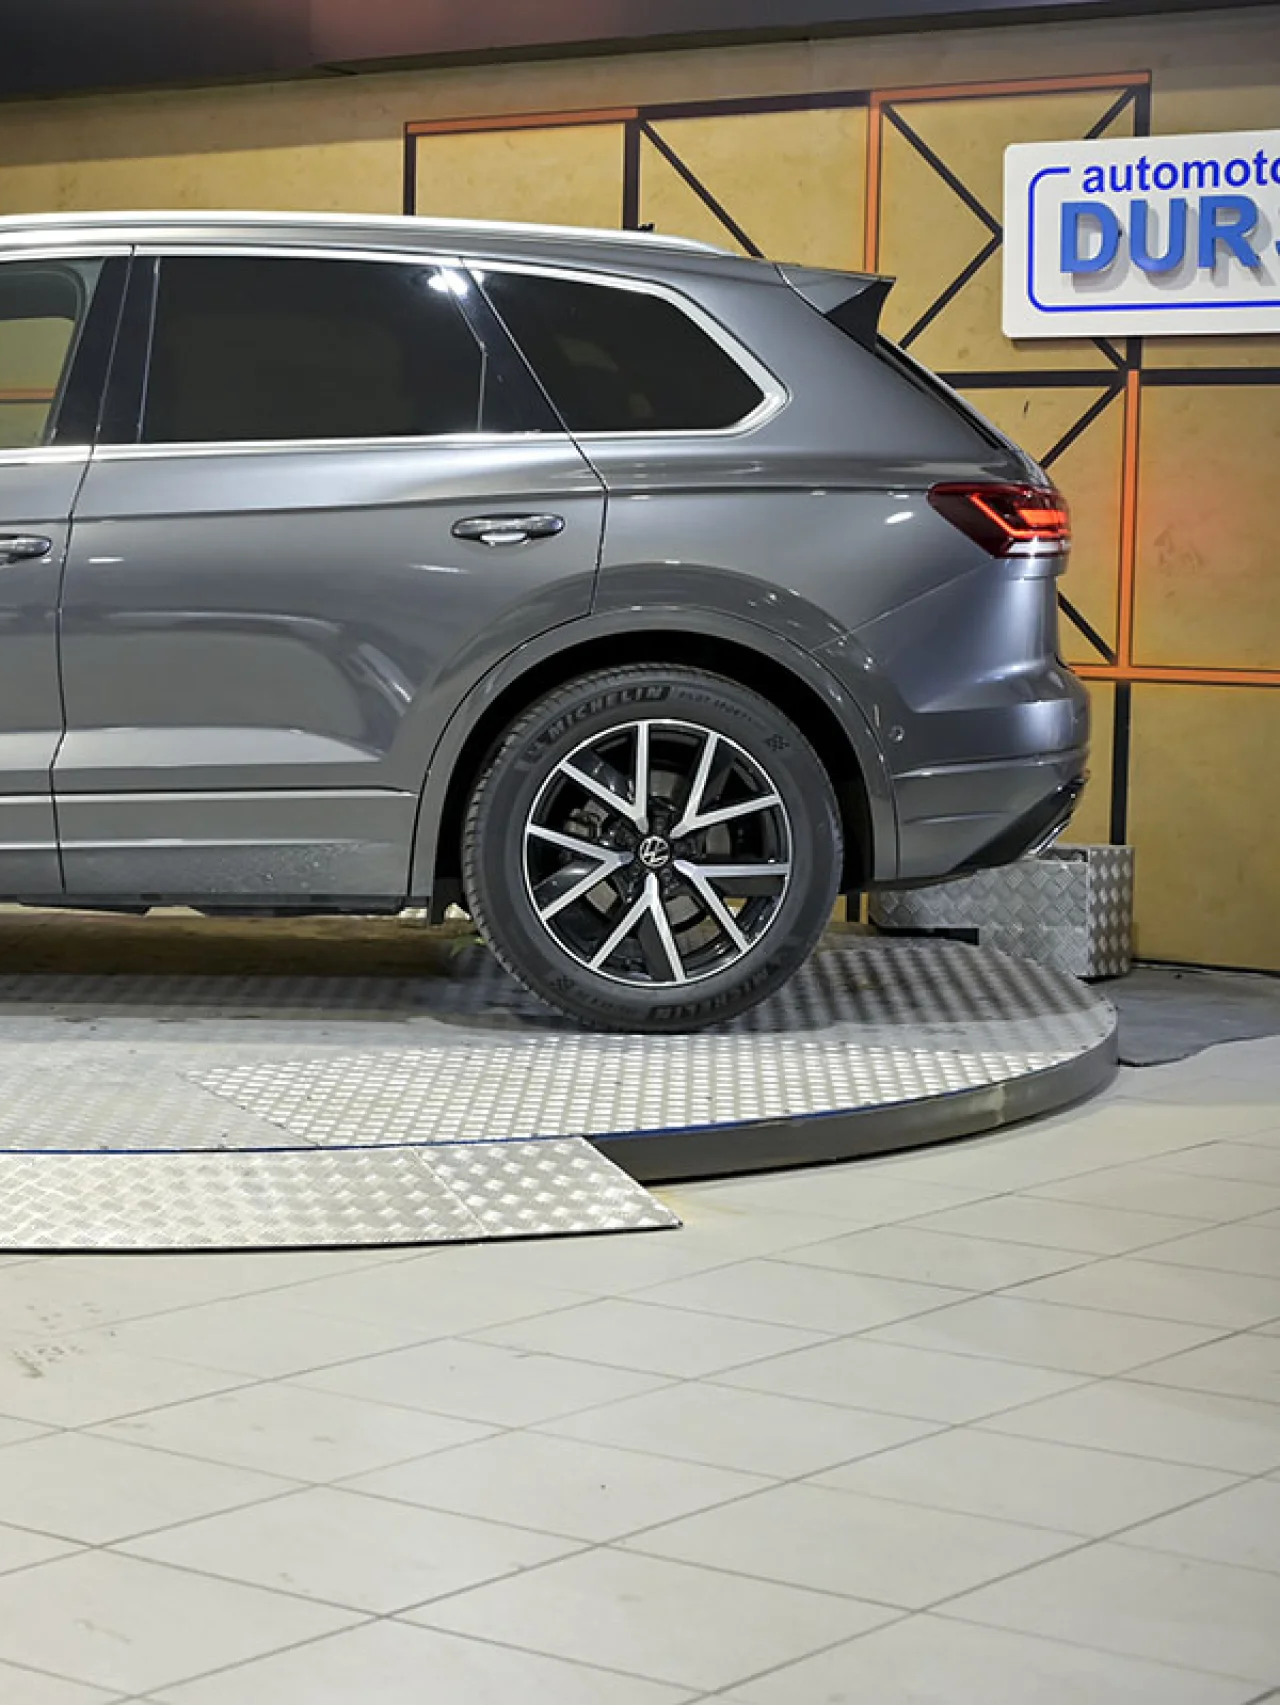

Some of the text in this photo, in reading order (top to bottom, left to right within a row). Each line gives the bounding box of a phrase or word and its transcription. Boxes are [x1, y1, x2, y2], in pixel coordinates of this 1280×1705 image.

[1081, 148, 1280, 194] automoto
[1059, 194, 1280, 274] DUR
[544, 686, 663, 741] MICHELIN
